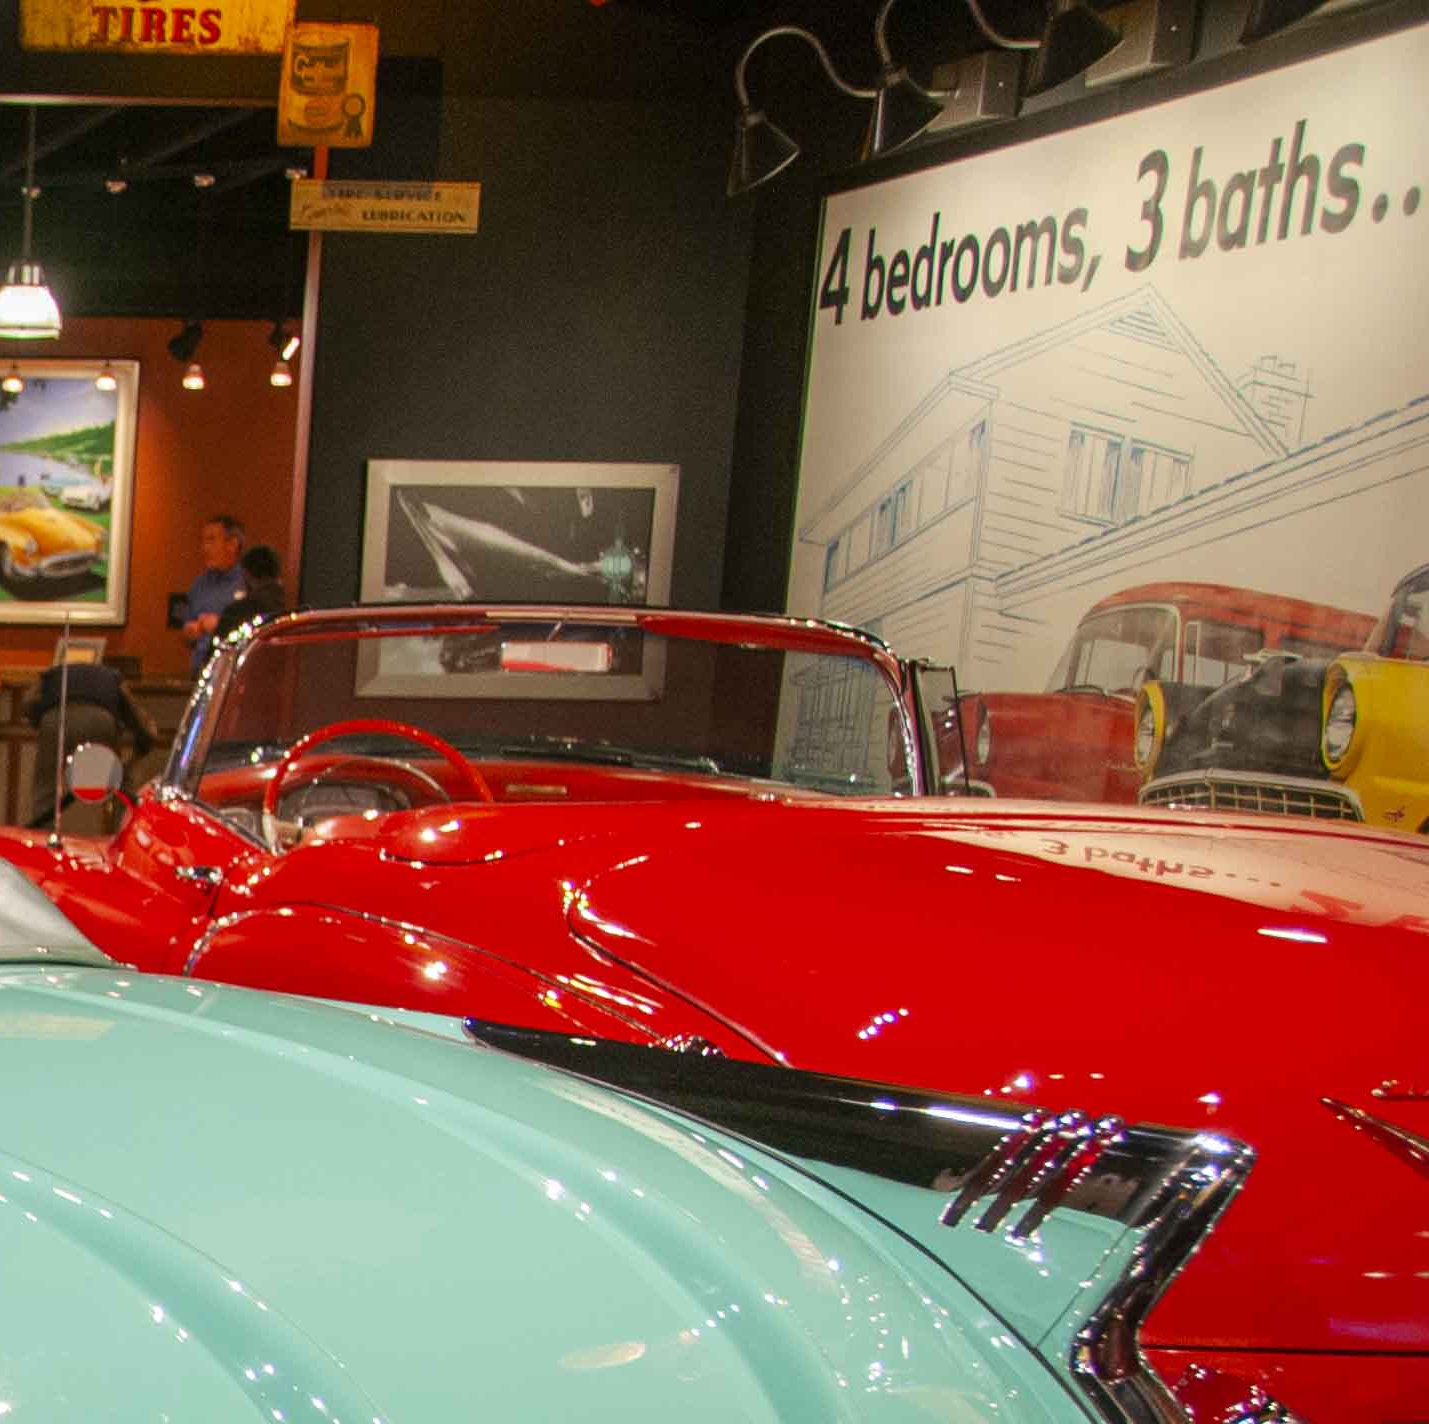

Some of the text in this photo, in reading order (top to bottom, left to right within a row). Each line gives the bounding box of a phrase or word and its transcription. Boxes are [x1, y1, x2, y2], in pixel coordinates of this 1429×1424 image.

[92, 7, 221, 44] TIRES
[362, 209, 468, 223] LUBRICATION
[818, 227, 852, 326] 4
[860, 211, 1103, 321] bedrooms,
[1124, 149, 1170, 273] 3
